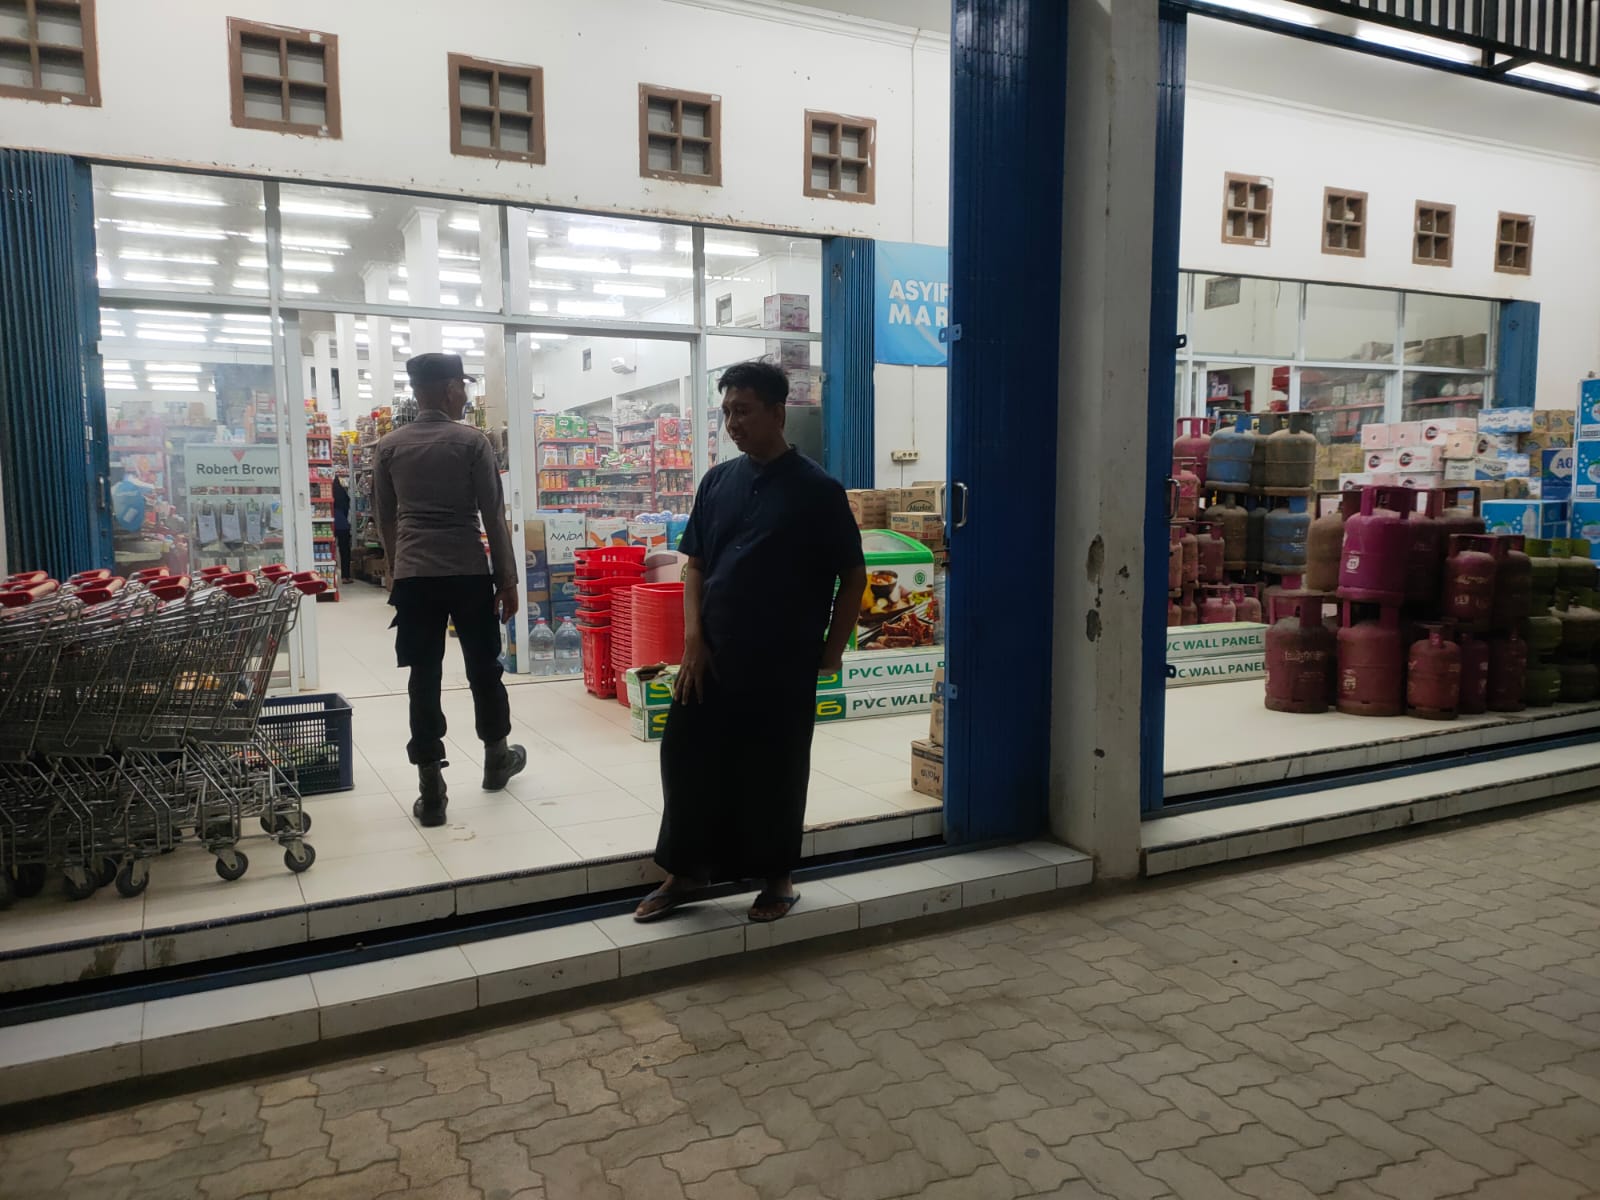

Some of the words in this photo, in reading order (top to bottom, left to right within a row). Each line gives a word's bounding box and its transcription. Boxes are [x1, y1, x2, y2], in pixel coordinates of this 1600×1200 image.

[889, 303, 948, 328] MAR
[196, 463, 238, 475] Robert
[1183, 638, 1219, 650] WALL
[1221, 635, 1262, 647] PANEL
[848, 665, 883, 680] PVC
[886, 661, 933, 676] WALL
[1189, 666, 1226, 677] WALL
[852, 697, 887, 711] PVC
